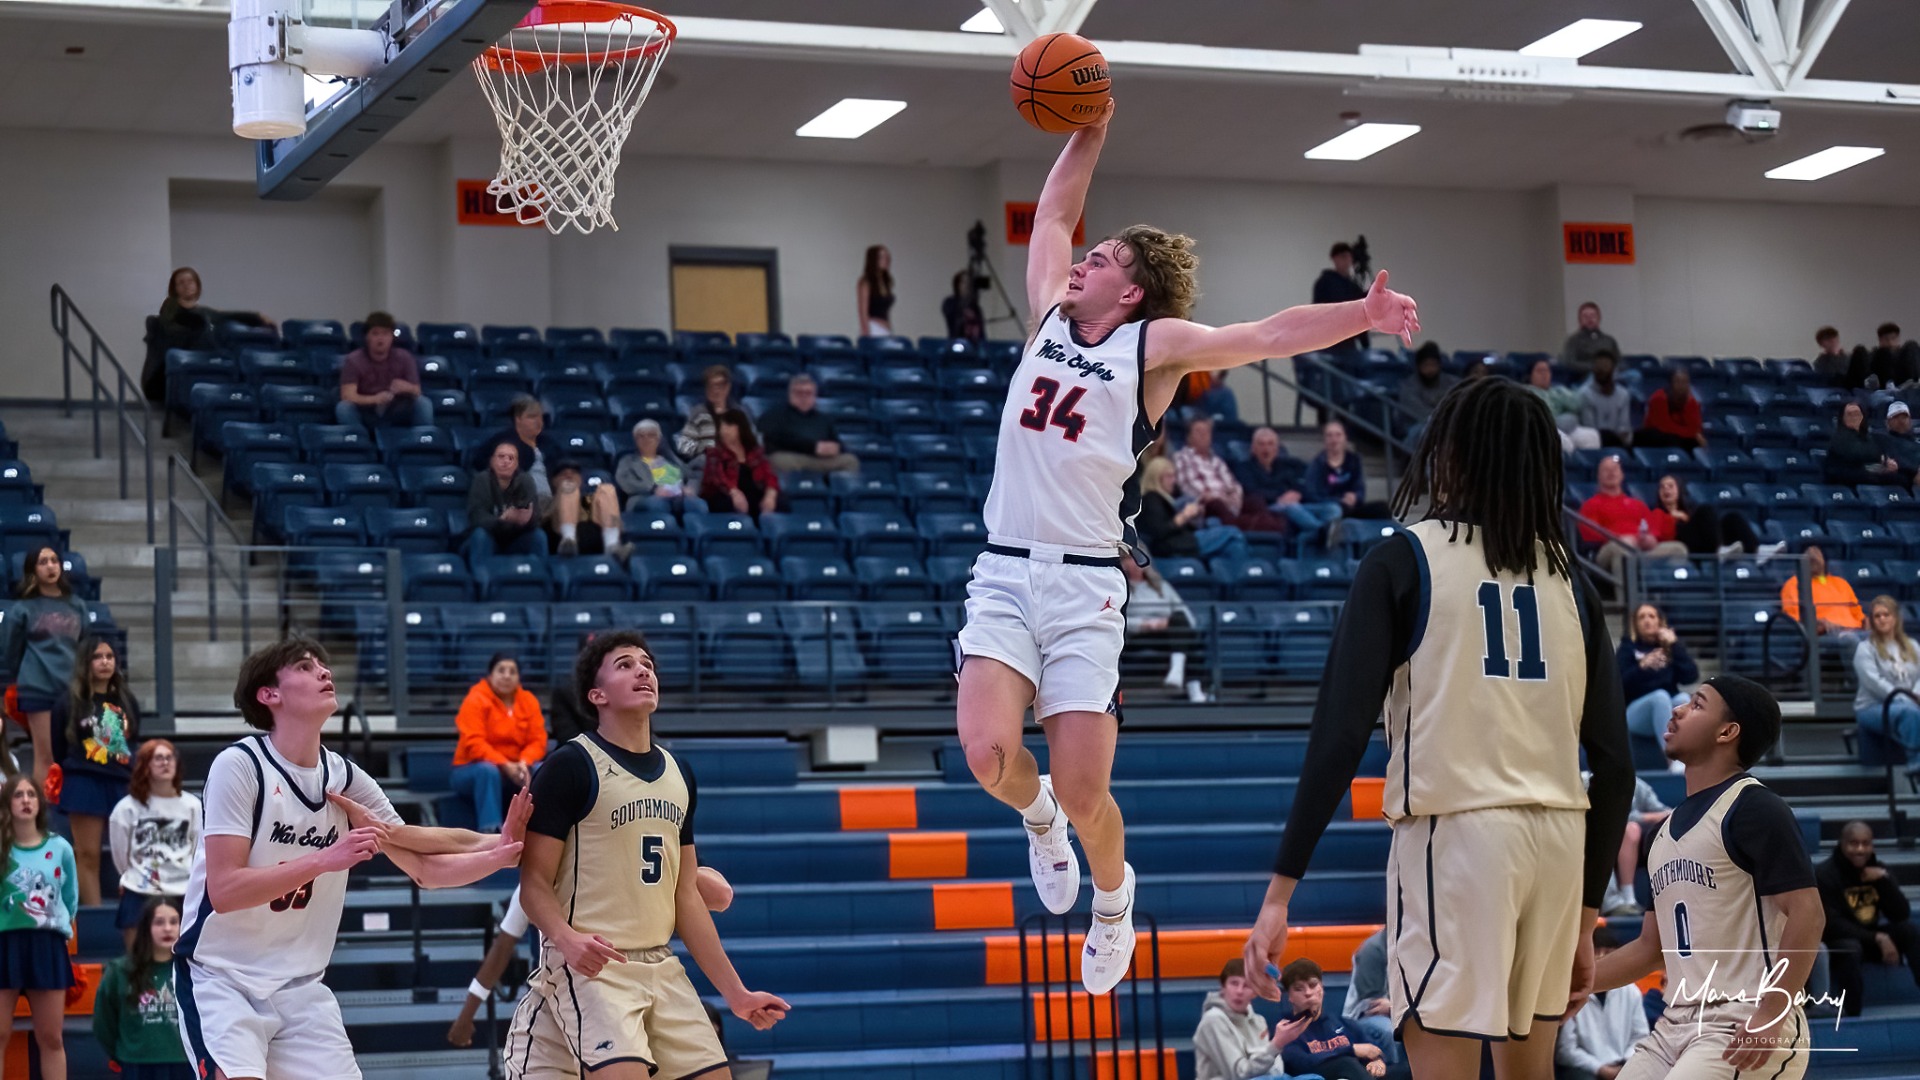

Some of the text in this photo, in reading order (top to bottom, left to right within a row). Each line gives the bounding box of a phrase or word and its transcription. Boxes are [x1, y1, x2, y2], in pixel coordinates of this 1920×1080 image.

[1569, 230, 1630, 255] HOME
[1035, 339, 1115, 381] War Eagles
[1020, 376, 1088, 443] 34
[1476, 580, 1548, 681] 11
[270, 821, 296, 845] War
[610, 798, 684, 830] SOUTHMOOR
[640, 834, 664, 885] 5
[1674, 901, 1692, 958] 0
